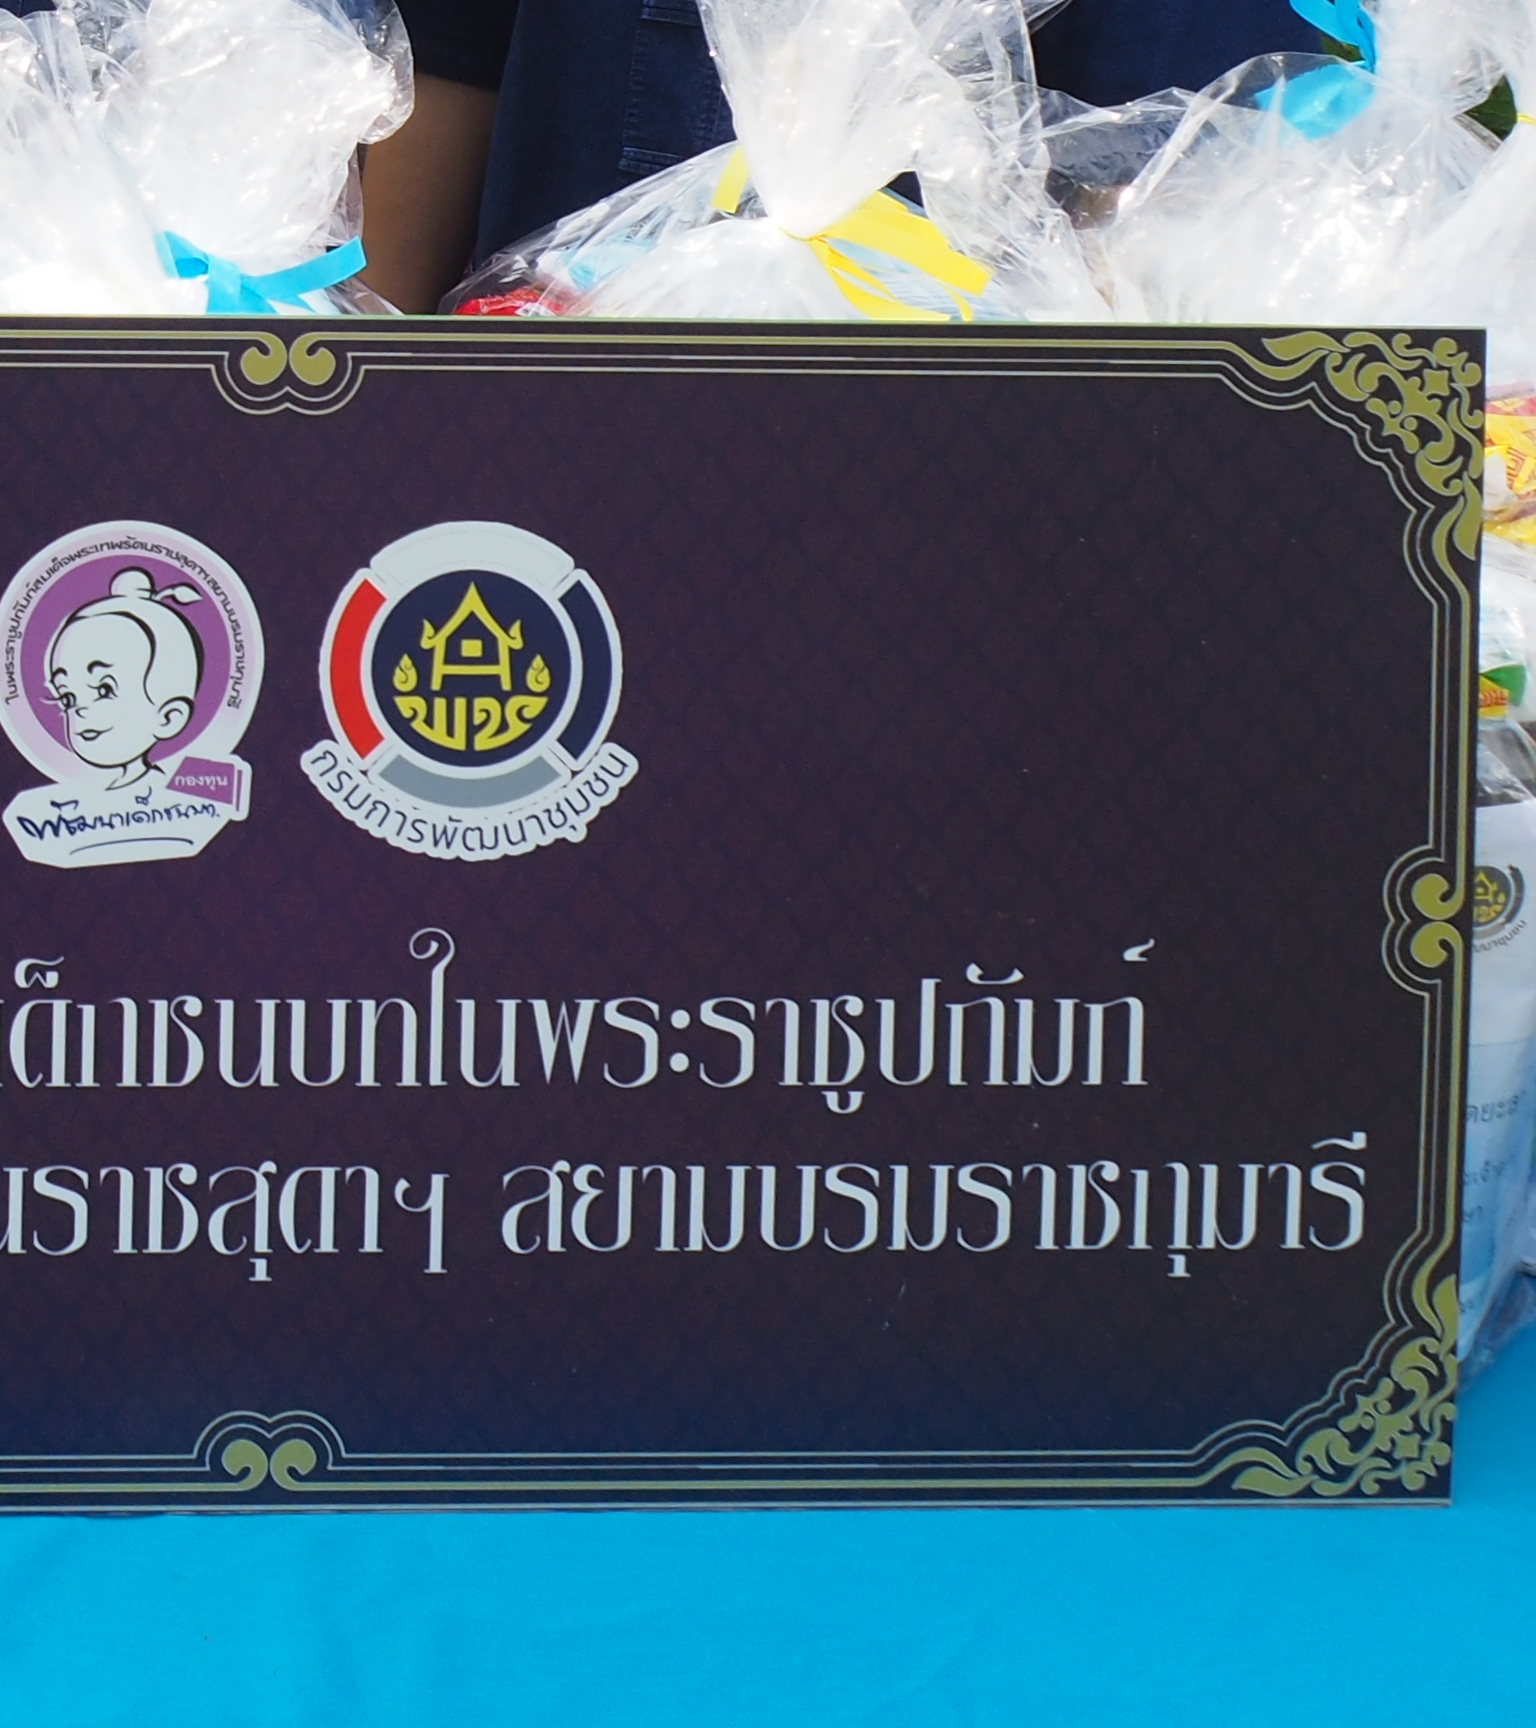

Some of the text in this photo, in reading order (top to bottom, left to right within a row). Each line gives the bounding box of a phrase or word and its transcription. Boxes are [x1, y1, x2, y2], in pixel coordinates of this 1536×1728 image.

[175, 773, 229, 790] กองทุน
[311, 748, 628, 852] กรมการพัฒนาชุมชน
[502, 1133, 1366, 1276] สยามบรมราชกุมารี
